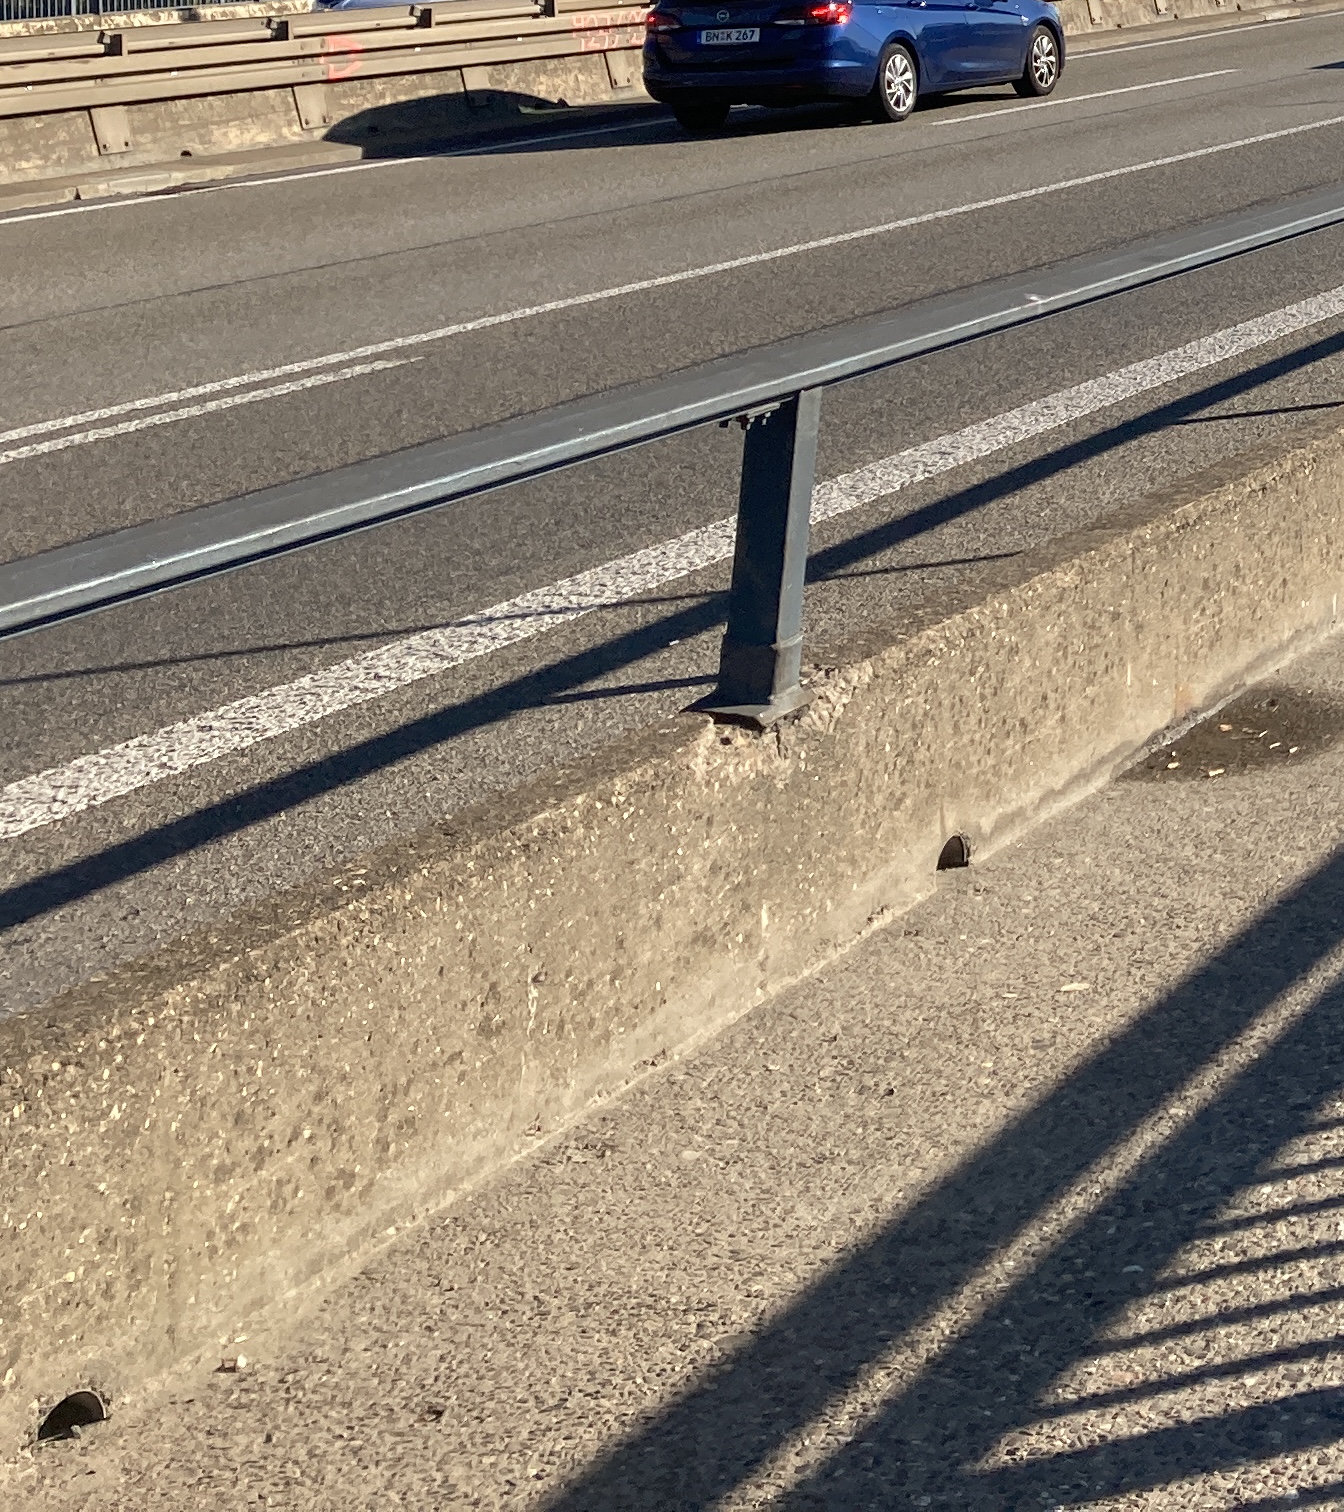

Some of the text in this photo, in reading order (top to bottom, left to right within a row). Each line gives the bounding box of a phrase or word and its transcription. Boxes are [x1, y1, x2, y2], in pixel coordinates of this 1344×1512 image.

[705, 29, 756, 42] BN K 267
